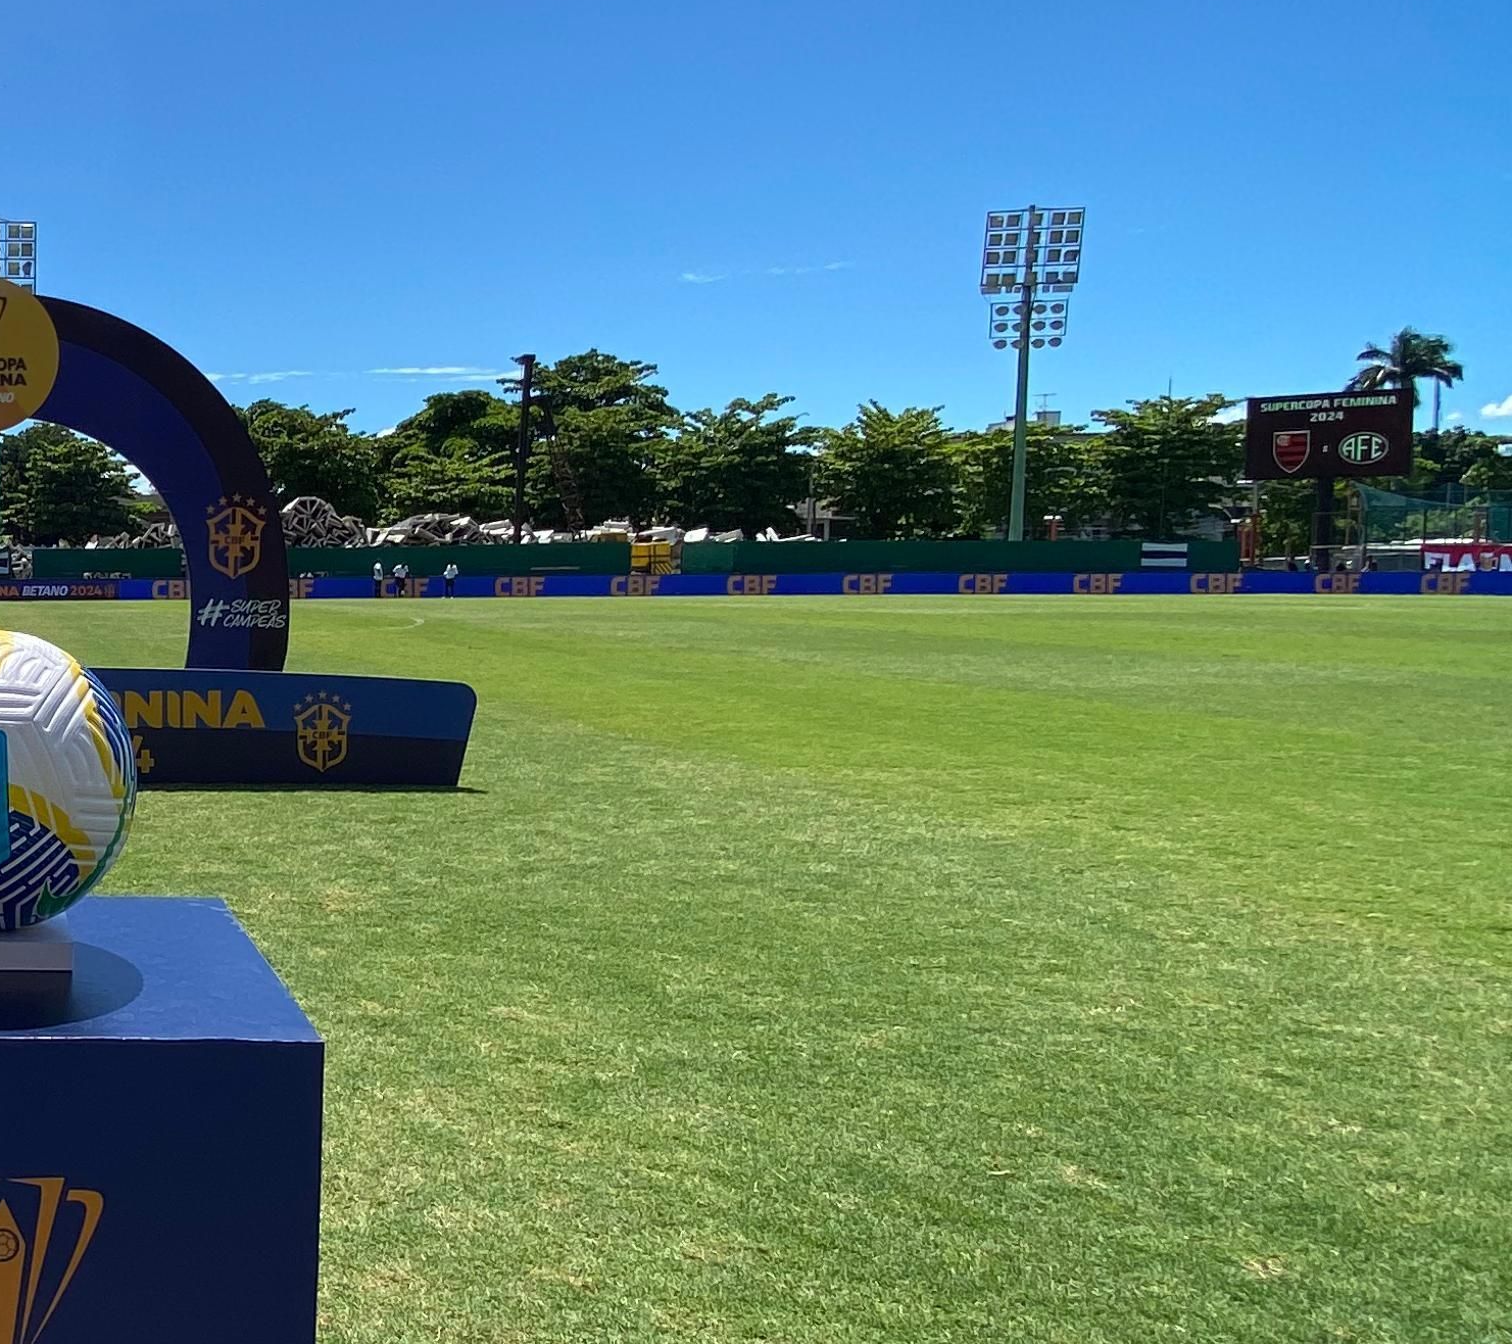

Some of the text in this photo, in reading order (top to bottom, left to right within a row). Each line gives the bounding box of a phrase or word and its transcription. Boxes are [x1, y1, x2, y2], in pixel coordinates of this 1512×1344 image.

[1260, 395, 1397, 413] SUPERCOPA FEMININA
[1309, 411, 1344, 423] 2024
[1342, 436, 1383, 461] AFE
[21, 584, 69, 597] BETANO
[70, 584, 103, 597] 2024
[151, 580, 191, 599] CB
[495, 576, 546, 597] CBF
[610, 575, 662, 596] CBF
[727, 575, 777, 595] CBF
[842, 574, 893, 594] CBF
[958, 574, 1009, 594] CBF
[1073, 574, 1124, 594] CBF
[1190, 573, 1244, 593] CBF
[1315, 573, 1360, 593] CBF
[1421, 572, 1471, 593] CBF
